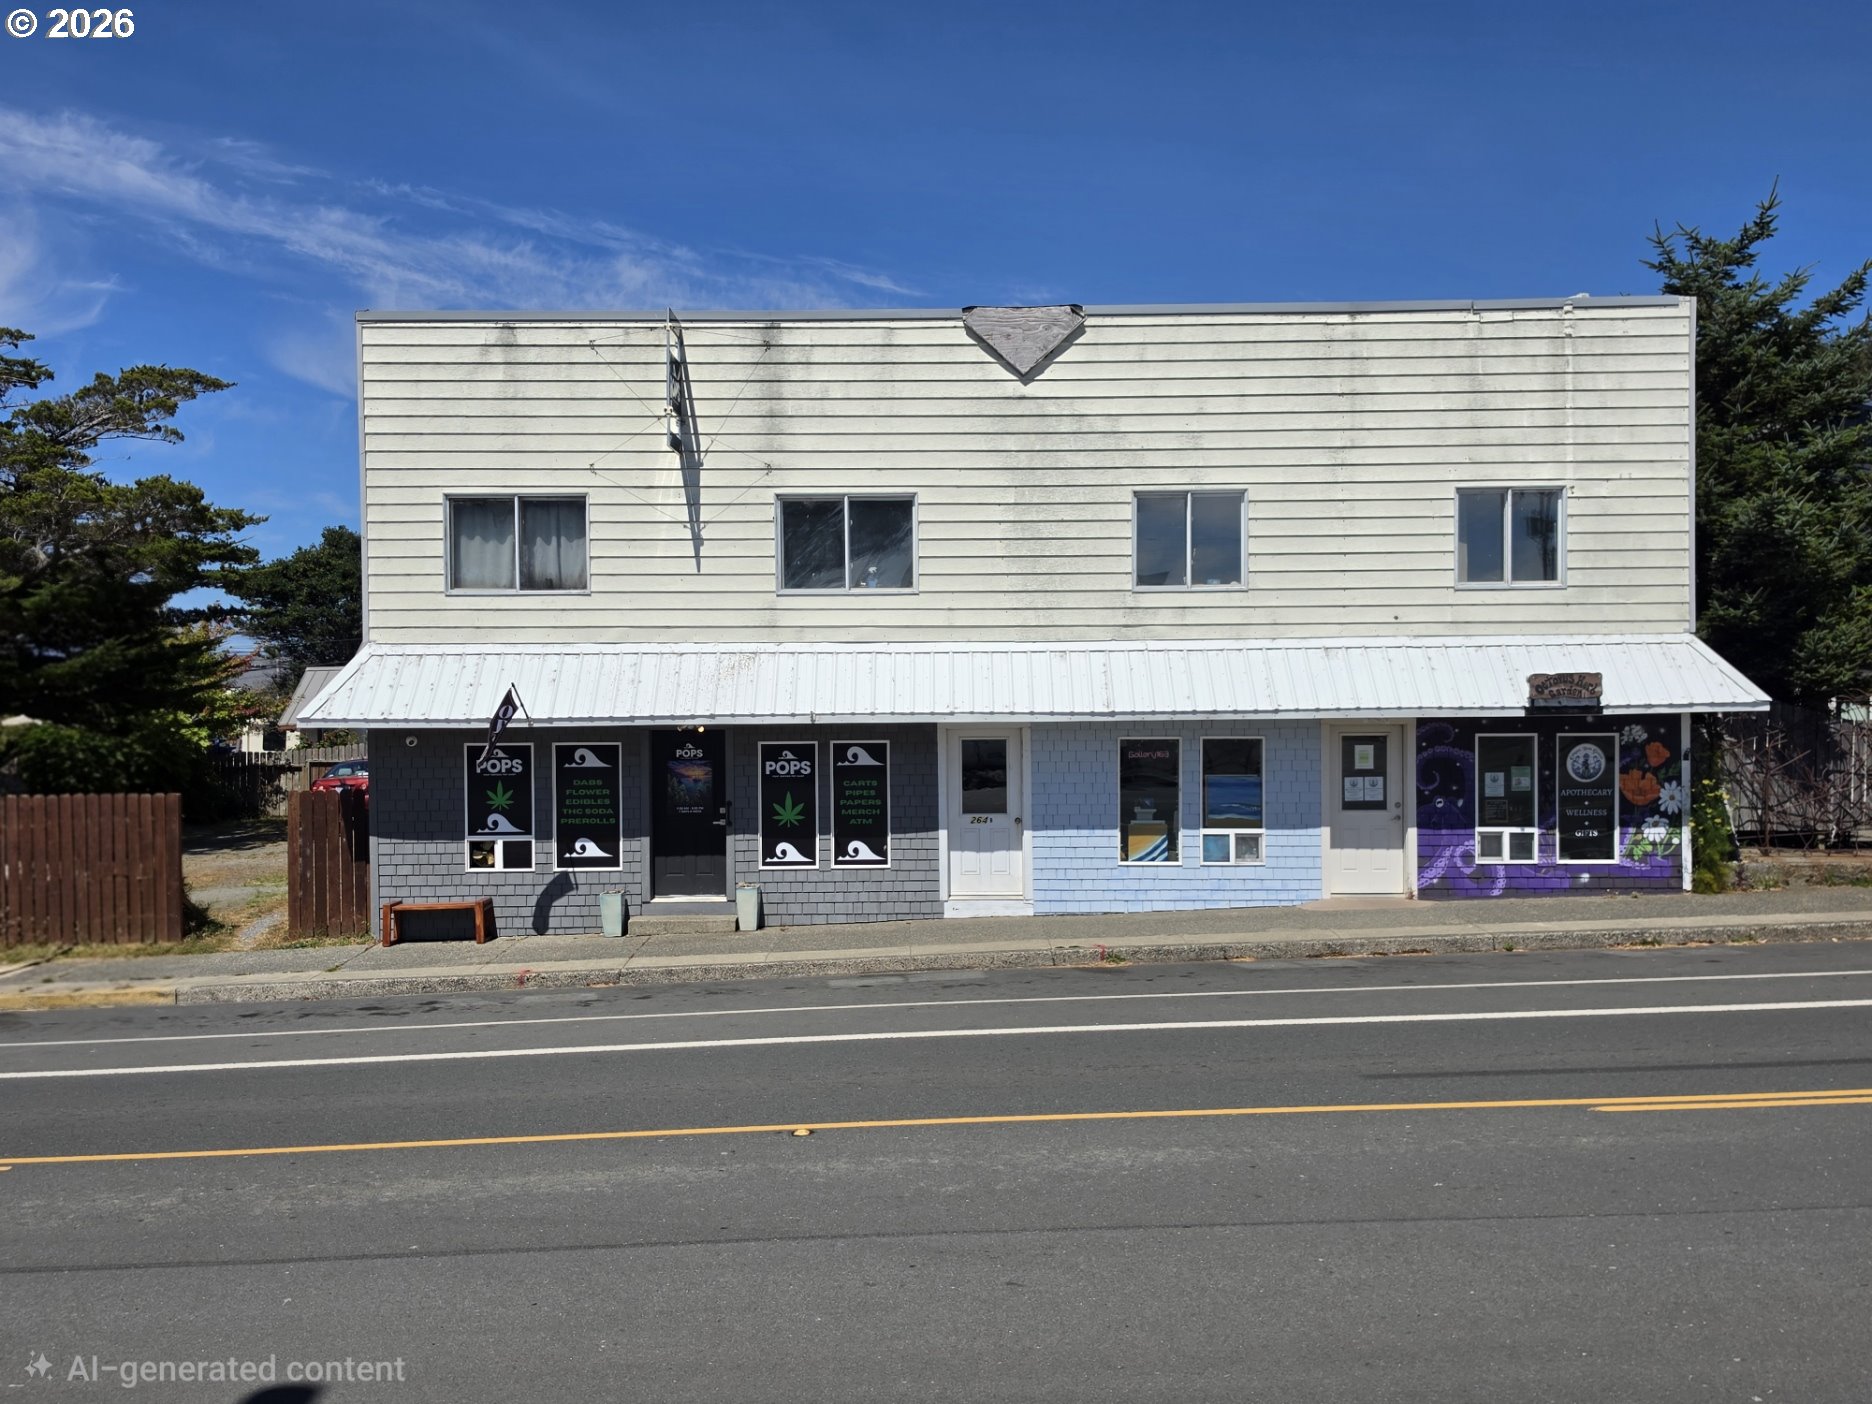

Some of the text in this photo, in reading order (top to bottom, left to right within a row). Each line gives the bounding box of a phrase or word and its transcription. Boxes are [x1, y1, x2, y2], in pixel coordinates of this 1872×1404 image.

[676, 749, 703, 758] POPS
[476, 759, 523, 774] POPS
[765, 760, 812, 775] POPS
[843, 779, 878, 787] CARTS
[1560, 789, 1613, 797] APOTHECARY
[1566, 809, 1608, 817] WELLNESS
[970, 816, 989, 825] 264
[1574, 829, 1599, 837] GIFTS
